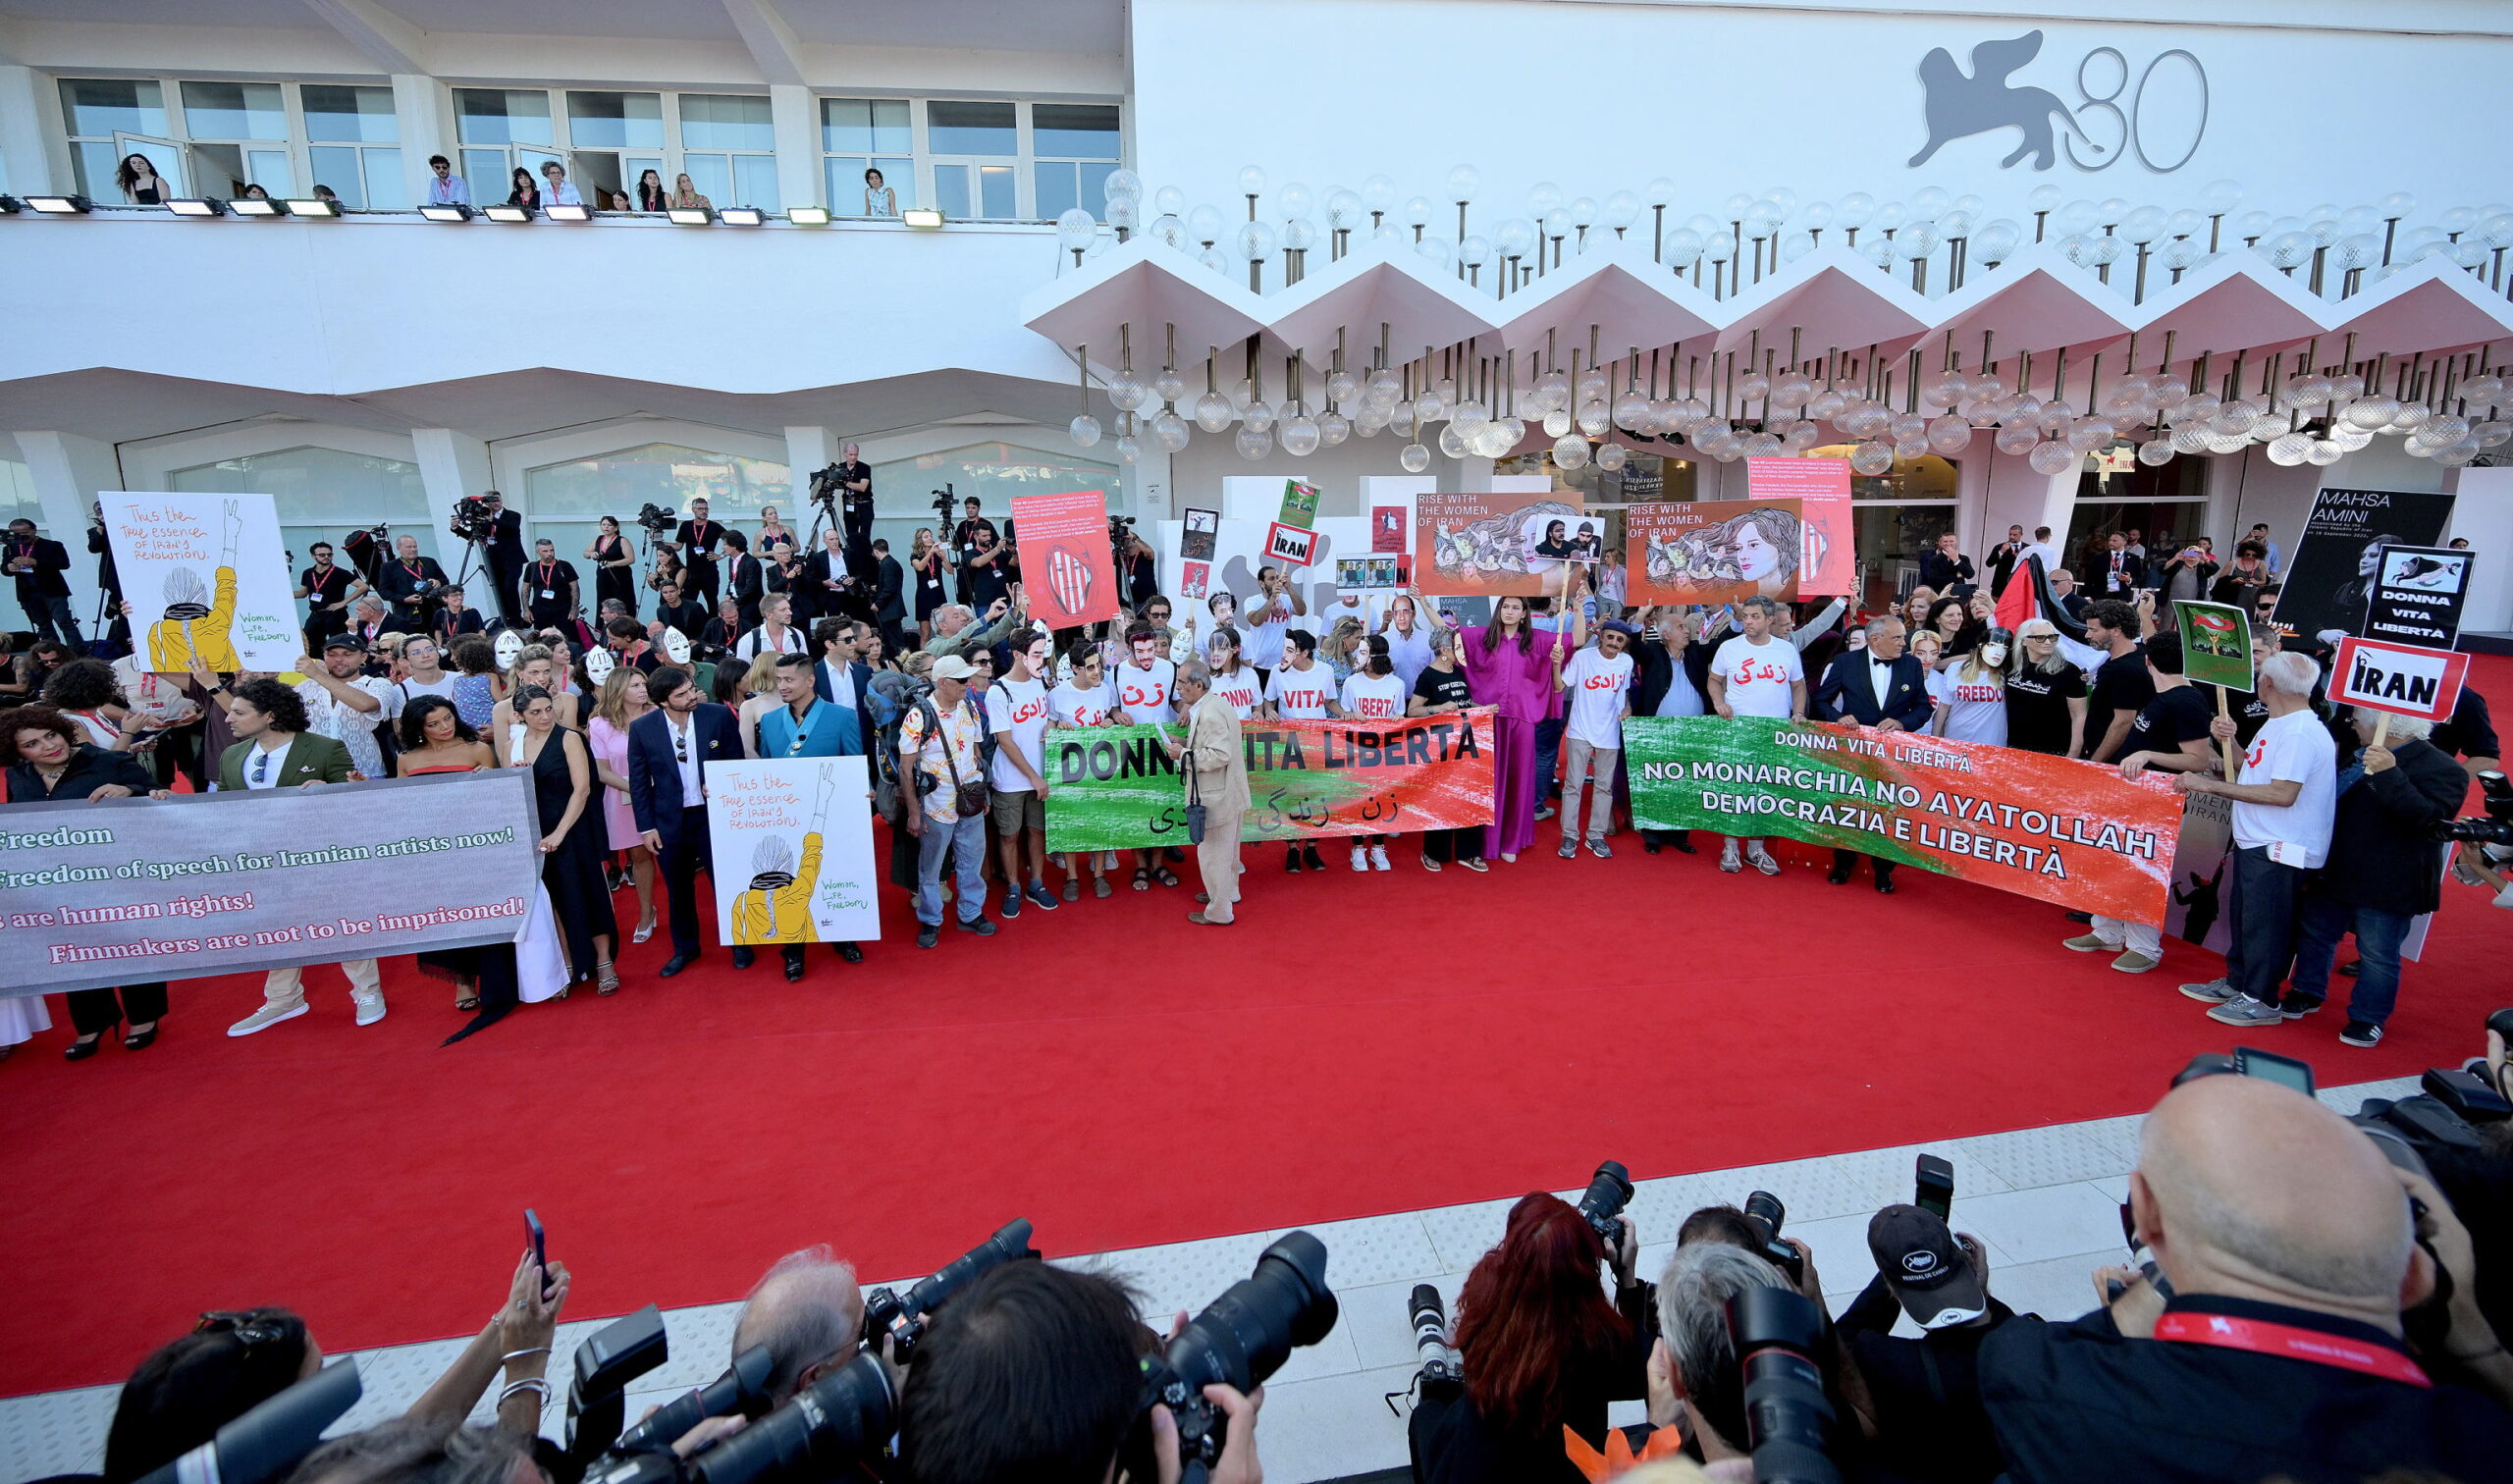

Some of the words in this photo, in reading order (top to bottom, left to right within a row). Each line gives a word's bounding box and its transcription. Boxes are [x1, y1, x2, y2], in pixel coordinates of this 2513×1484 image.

[2064, 46, 2209, 174] 80
[1418, 495, 1443, 504] RISE
[1447, 494, 1476, 504] WITH
[1418, 505, 1440, 515] THE
[1444, 505, 1488, 515] WOMEN
[1630, 504, 1656, 515] RISE
[1660, 504, 1690, 514] WITH
[2320, 492, 2390, 507] MAHSA
[1418, 518, 1432, 527] OF
[1437, 517, 1464, 527] IRAN
[1630, 516, 1652, 527] THE
[1657, 515, 1703, 526] WOMEN
[2313, 508, 2369, 523] AMINI
[1630, 528, 1644, 538] OF
[1649, 527, 1677, 538] IRAN
[1274, 531, 1308, 558] IRAN
[2381, 591, 2450, 607] DONNA
[2391, 609, 2432, 620] VITA
[2374, 622, 2445, 639] LIBERTÀ
[1734, 658, 1787, 685] زندگی
[1956, 685, 2005, 703] FREEDO
[2351, 661, 2437, 706] IRAN
[1122, 683, 1164, 708] زن
[1283, 689, 1324, 709] VITA
[1061, 737, 1182, 783] DONN
[1241, 731, 1306, 771] ITA
[1324, 713, 1479, 769] LIBERTÀ
[1775, 731, 1838, 752] DONNA
[1847, 738, 1886, 759] VITA
[1895, 745, 1972, 773] LIBERTÀ
[1258, 787, 1329, 833] زندگی
[1362, 793, 1398, 822] زن
[1643, 762, 1684, 781] NO
[1692, 762, 1867, 798] MONARCHIA
[1876, 779, 1921, 808] NO
[1928, 791, 2156, 860] AYATOLLAH
[2190, 805, 2231, 825] IRAN
[1702, 790, 1886, 835] DEMOCRAZIA
[1895, 817, 1911, 842] E
[1919, 822, 2066, 879] LIBERTÀ
[116, 860, 142, 879] of
[147, 856, 233, 880] speech
[235, 852, 273, 871] for
[279, 845, 370, 868] Iranian
[376, 835, 451, 858] artists
[456, 826, 514, 849] now!
[11, 914, 55, 928] are
[59, 905, 161, 927] human
[168, 892, 255, 919] rights!
[49, 937, 200, 965] Fimmakers
[206, 931, 249, 950] are
[256, 926, 301, 946] not
[306, 923, 335, 939] to
[339, 918, 372, 936] be
[377, 897, 525, 931] imprisoned!
